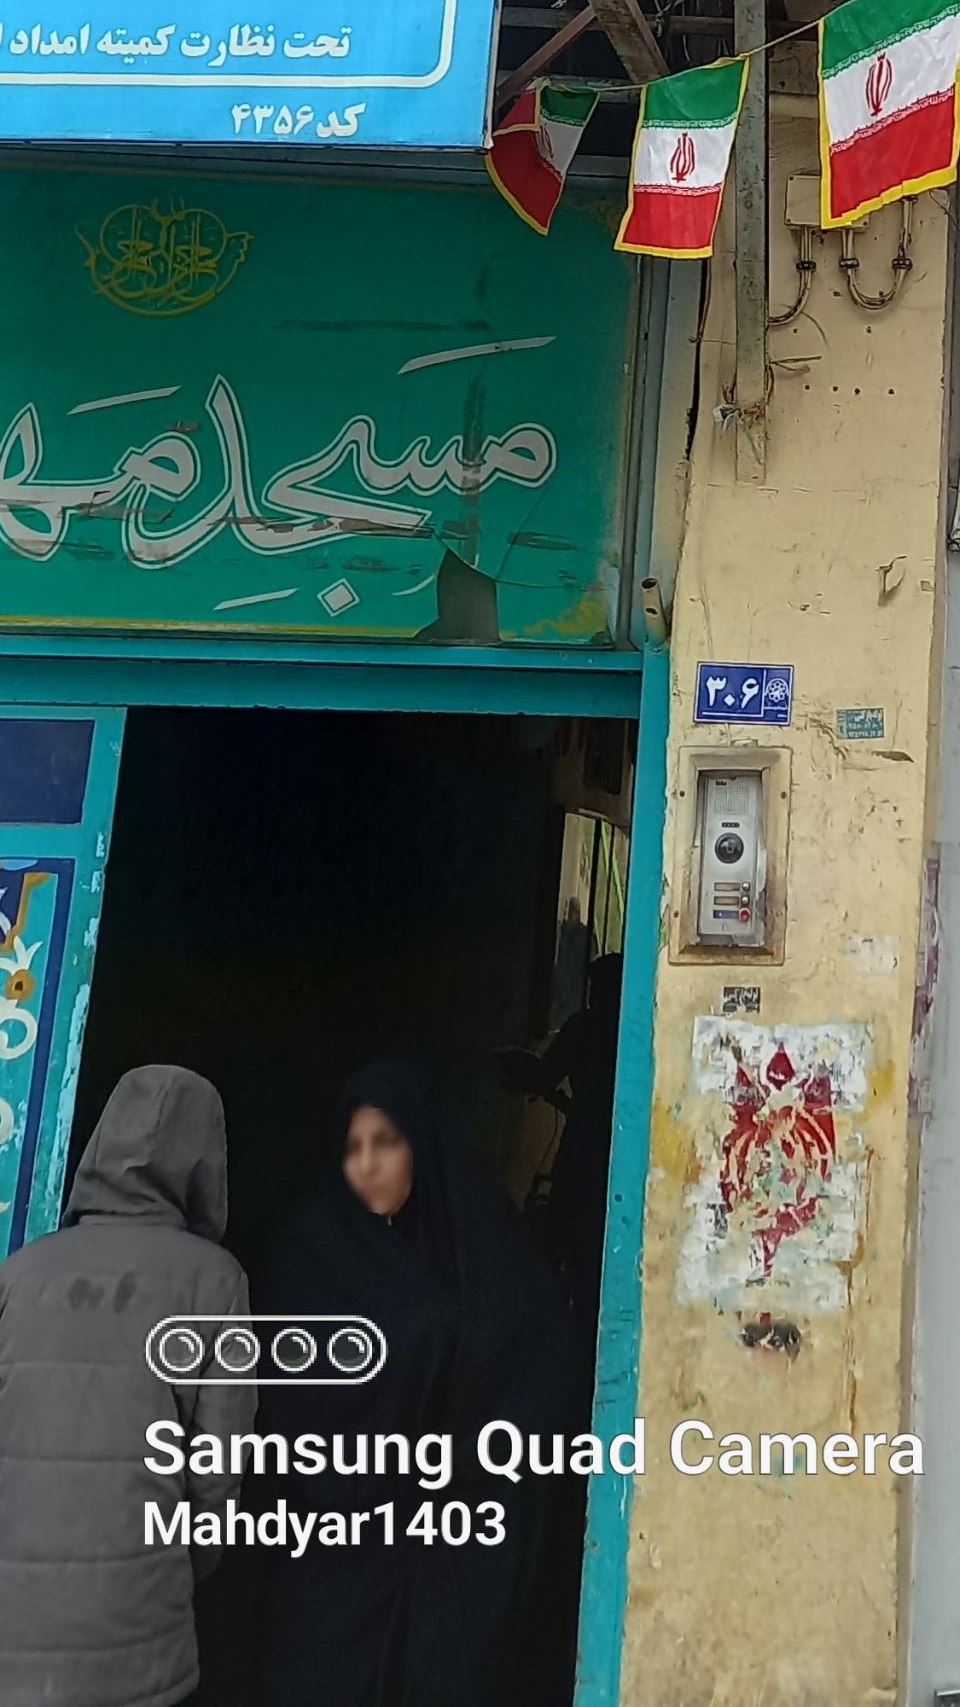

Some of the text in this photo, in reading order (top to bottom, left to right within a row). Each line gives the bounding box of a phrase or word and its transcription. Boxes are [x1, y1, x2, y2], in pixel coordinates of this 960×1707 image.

[10, 22, 353, 67] تحت نظارت کمیته امداد
[706, 676, 760, 709] ۳۰۶
